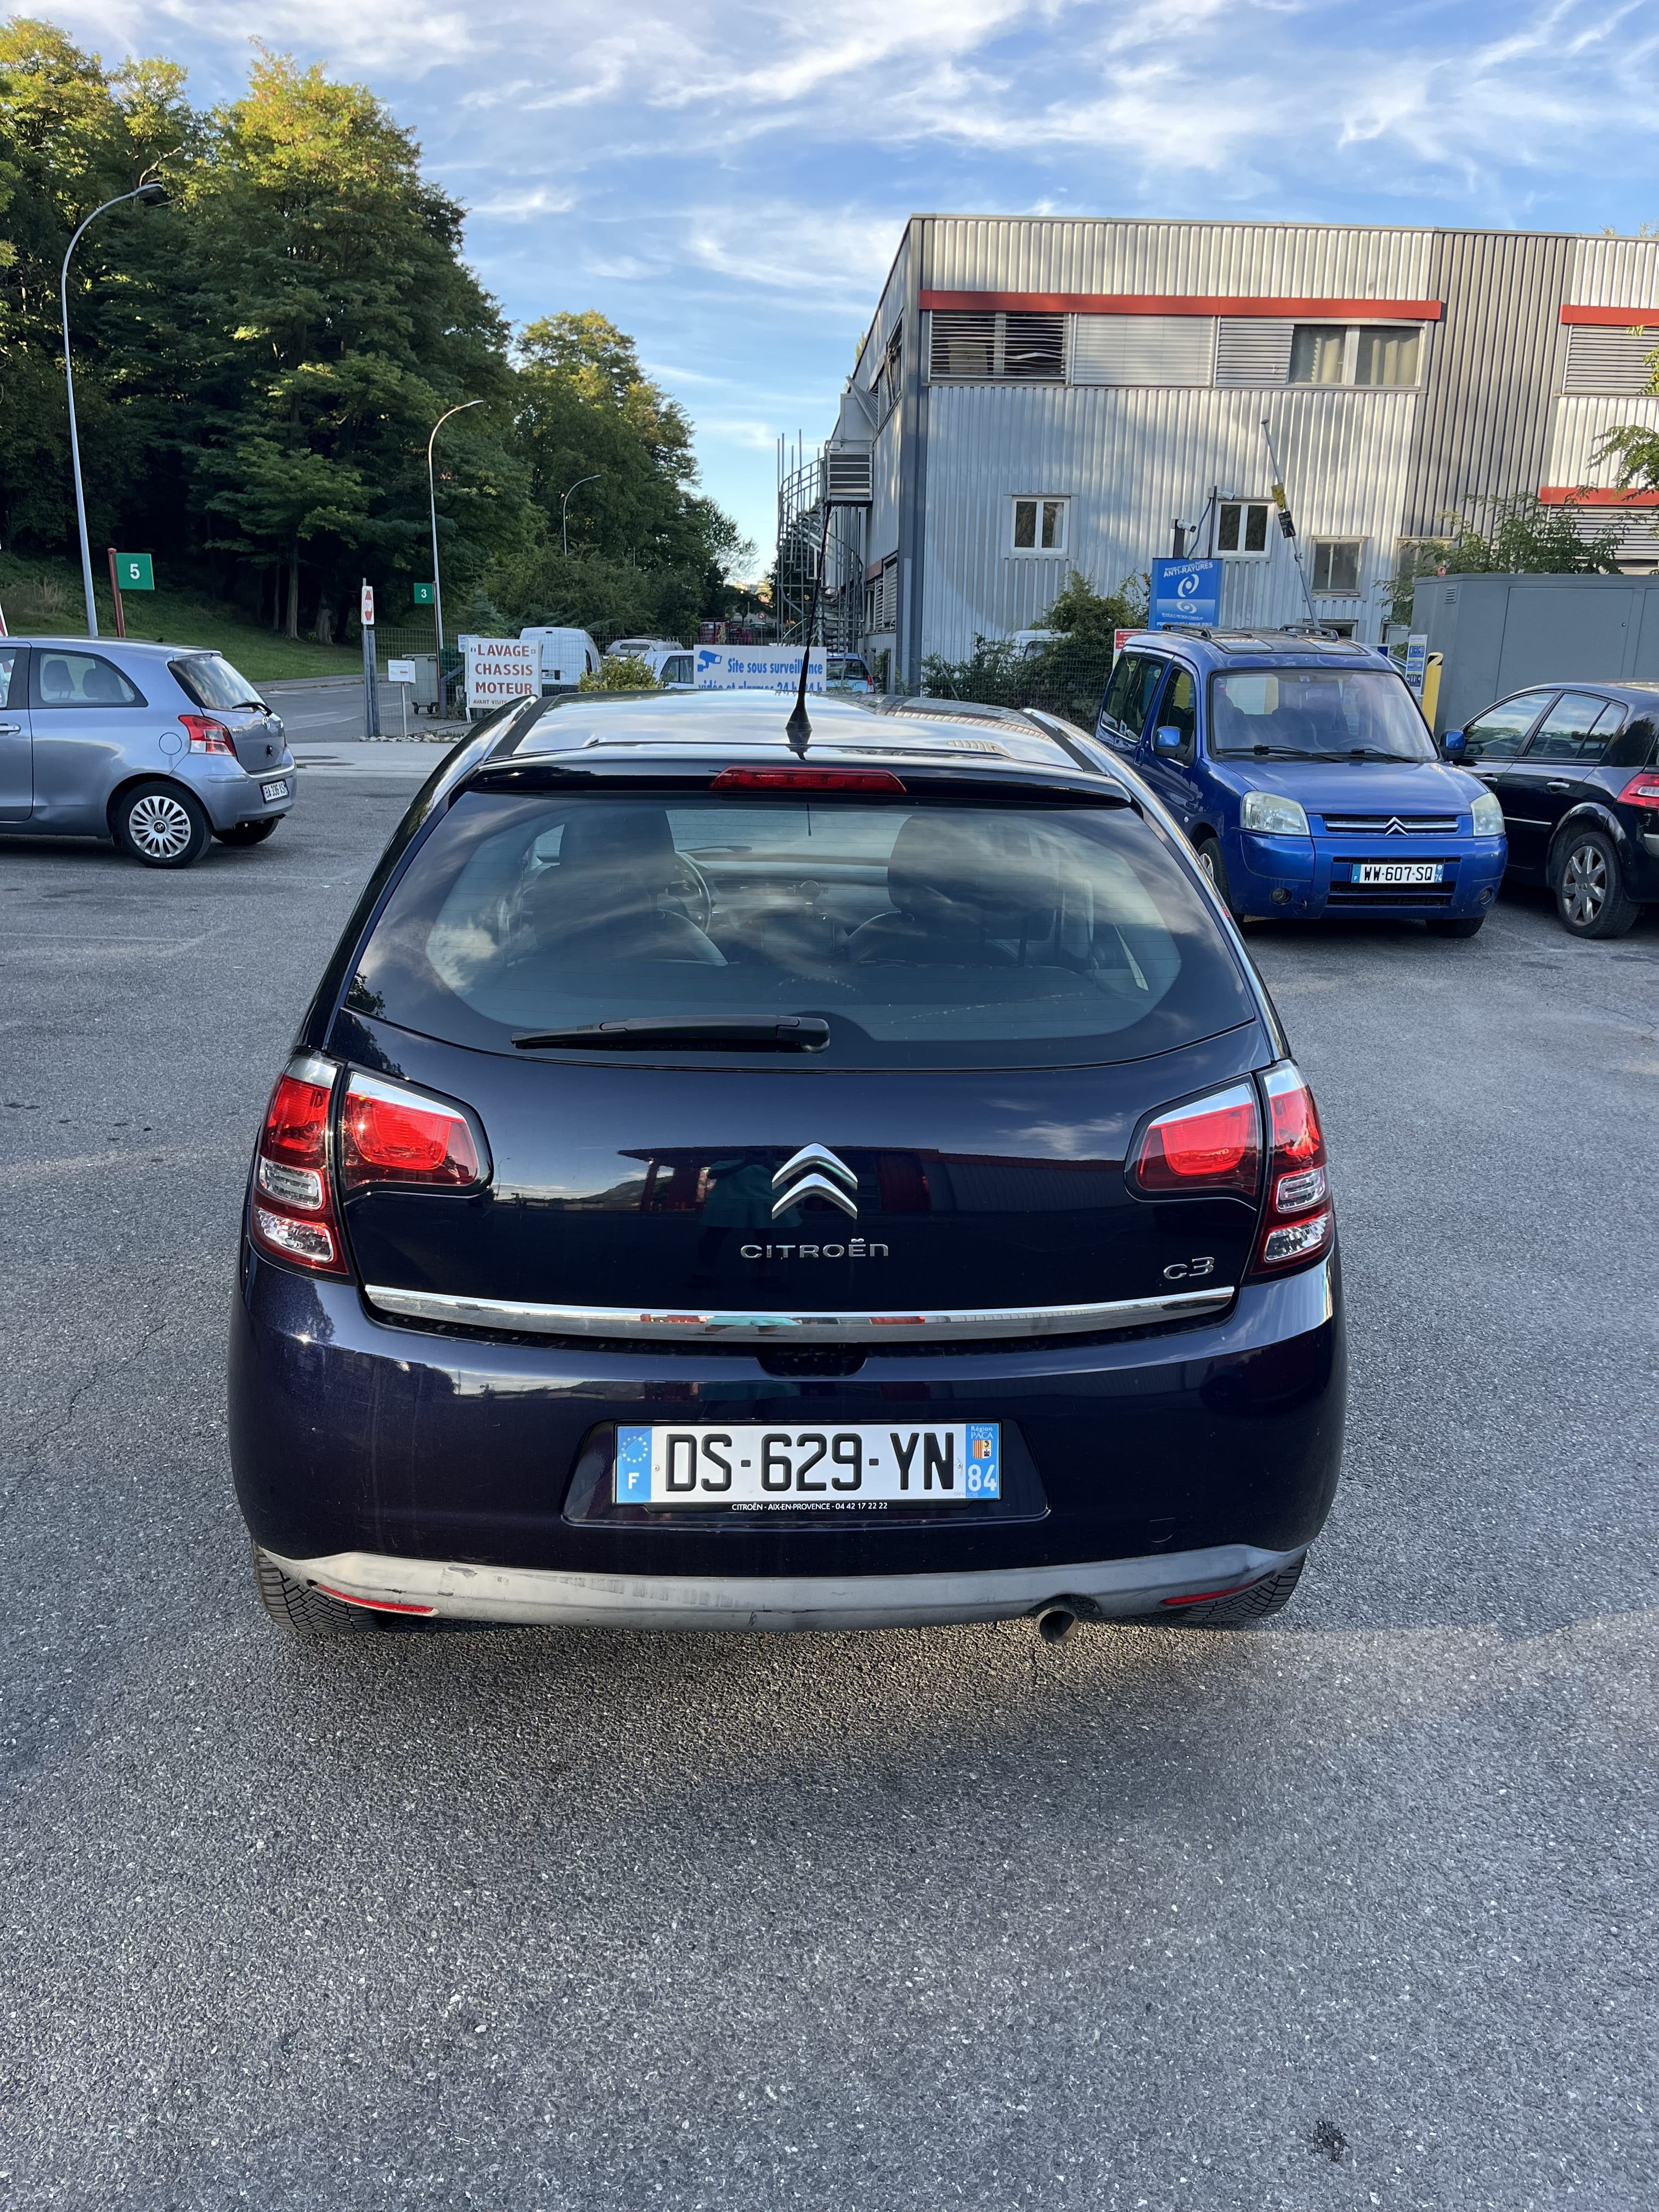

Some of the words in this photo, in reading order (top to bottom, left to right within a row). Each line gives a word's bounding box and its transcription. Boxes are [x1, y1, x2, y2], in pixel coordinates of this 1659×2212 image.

[130, 563, 140, 580] 5
[1163, 562, 1214, 578] ANTI-RAYURES
[421, 589, 427, 598] 3
[478, 644, 529, 657] LAVAGE
[475, 663, 533, 676] CHASSIS
[727, 657, 744, 673] Site
[747, 662, 767, 674] sous
[770, 658, 823, 674] surveillnce
[475, 682, 532, 695] MOTEUR
[1364, 866, 1433, 881] WW-607-SQ
[1164, 1256, 1215, 1279] C3
[665, 1432, 954, 1492] DS-629-YN
[628, 1472, 640, 1489] F
[968, 1464, 997, 1492] 84
[732, 1502, 763, 1510] CITROËN
